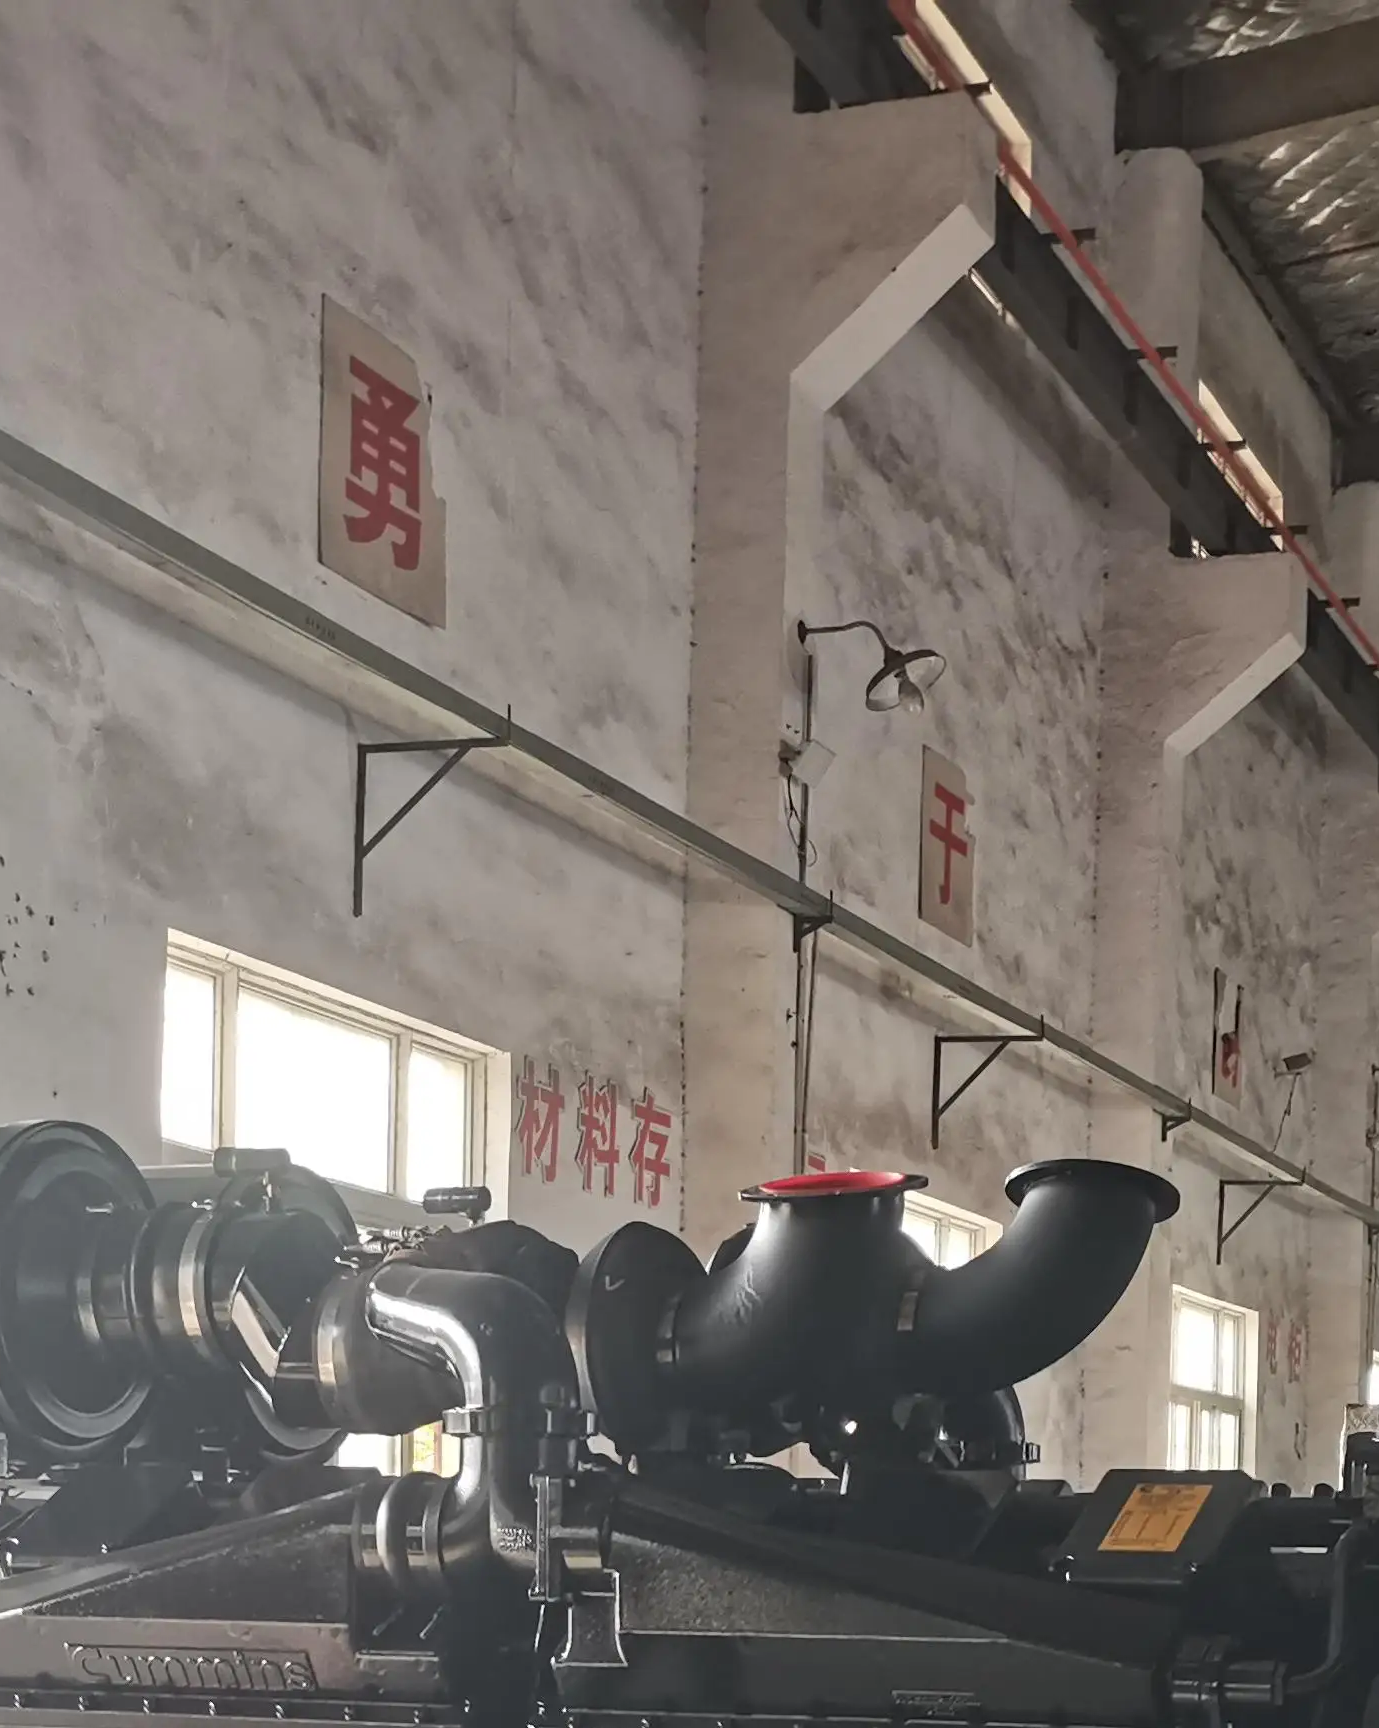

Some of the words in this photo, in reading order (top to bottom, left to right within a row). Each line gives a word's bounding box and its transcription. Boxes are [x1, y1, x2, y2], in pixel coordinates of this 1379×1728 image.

[342, 354, 422, 571] 勇
[515, 1055, 672, 1207] 材料存
